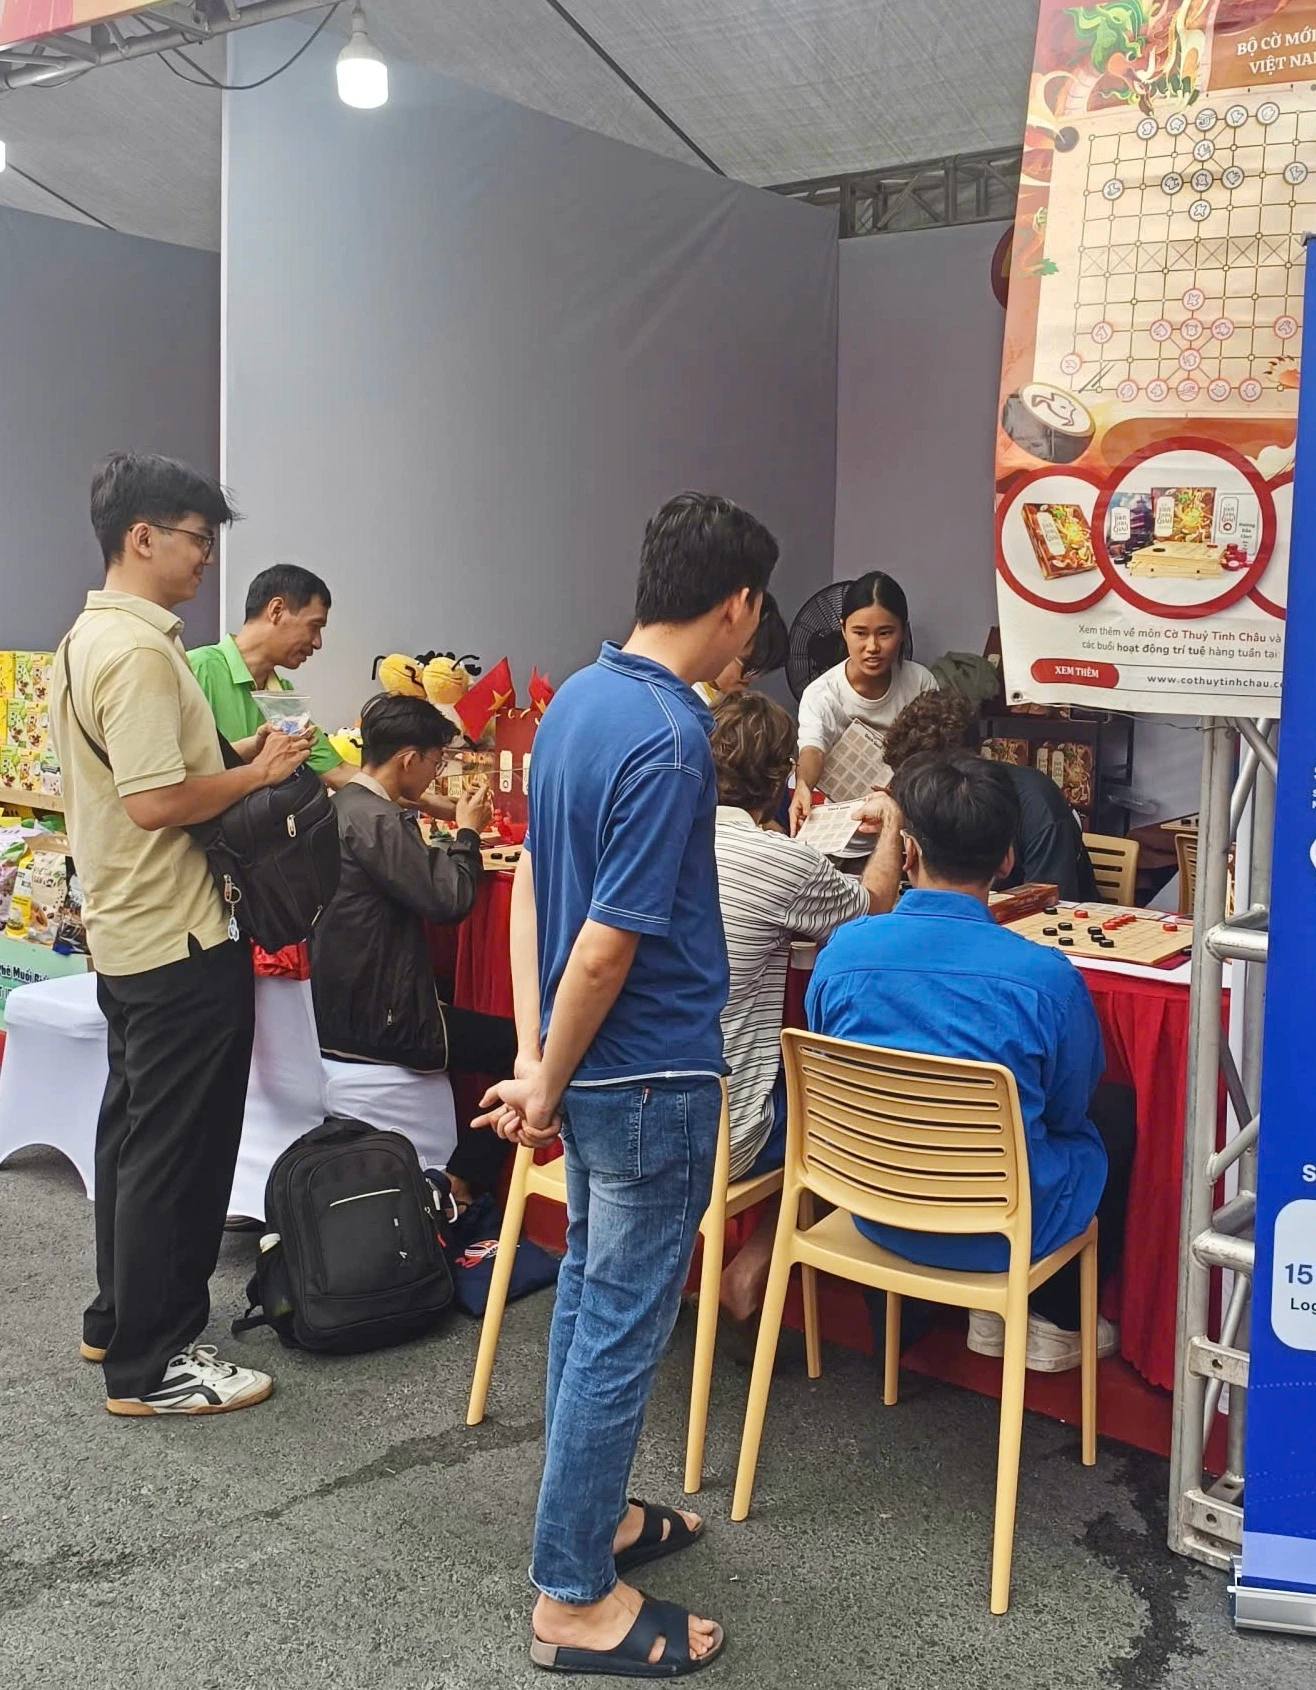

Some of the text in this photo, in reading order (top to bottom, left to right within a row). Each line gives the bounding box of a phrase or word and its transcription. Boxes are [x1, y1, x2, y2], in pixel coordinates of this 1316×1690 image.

[1236, 25, 1316, 57] BỘ CỜ MỚI
[1249, 51, 1316, 76] VIỆT NA
[1078, 624, 1098, 634] Xem
[1099, 626, 1120, 636] thêm
[1123, 627, 1135, 637] về
[1138, 629, 1161, 638] môn
[1164, 628, 1178, 639] Cờ
[1238, 632, 1266, 643] Châu
[1269, 633, 1282, 643] và
[1082, 641, 1278, 660] các buổi hoạt động trí tuệ hàng tuần tại
[1054, 665, 1099, 678] XEM THÊM
[1285, 1263, 1313, 1285] 15
